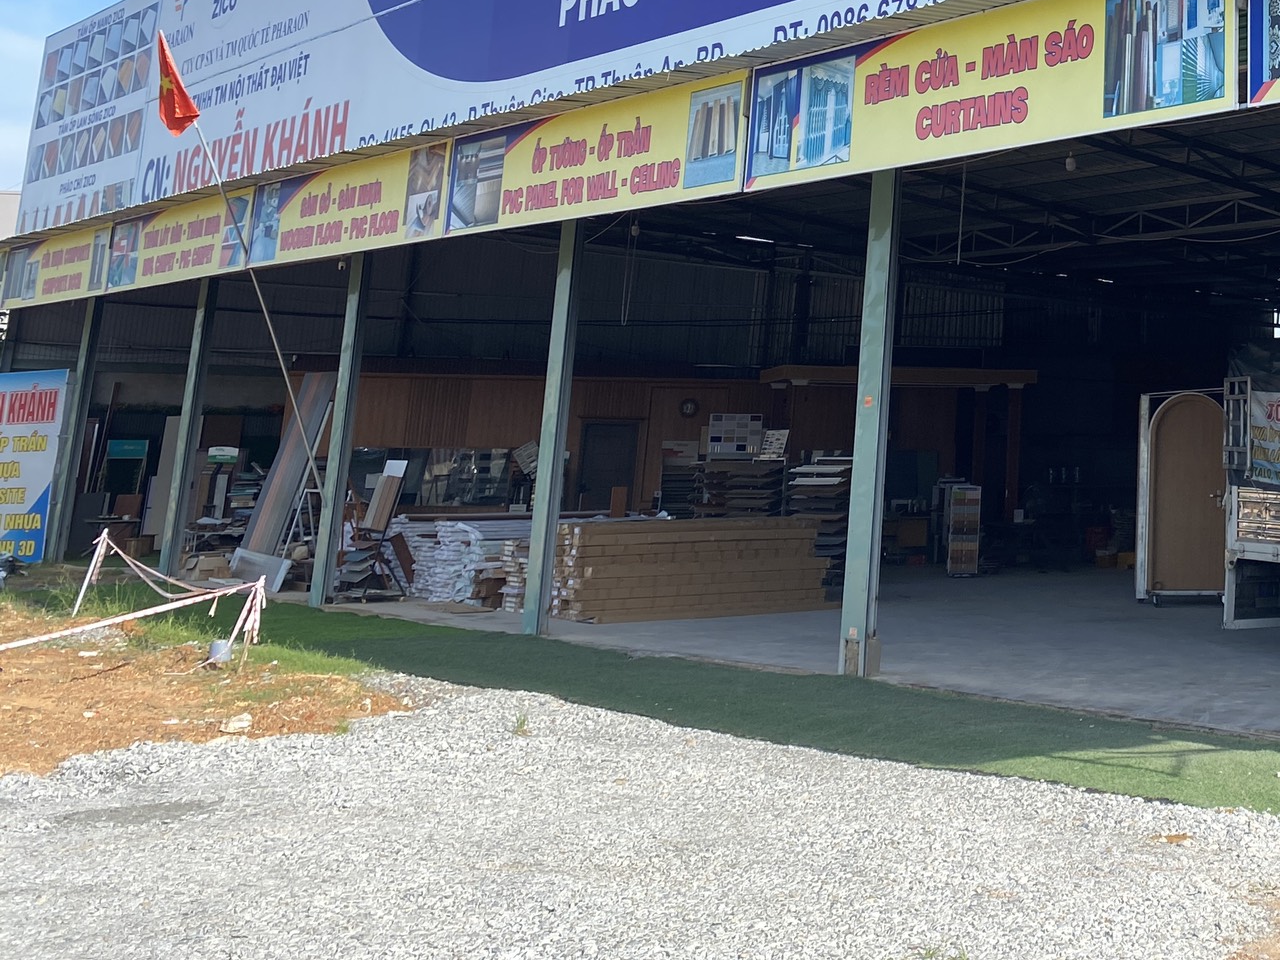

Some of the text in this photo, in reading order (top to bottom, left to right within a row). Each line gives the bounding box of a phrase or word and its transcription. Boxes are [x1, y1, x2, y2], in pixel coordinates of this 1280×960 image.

[215, 83, 228, 106] TM
[228, 74, 245, 106] NỘI
[247, 62, 270, 95] THẤT
[288, 50, 310, 85] VIỆT
[864, 62, 910, 106] RÈM
[914, 47, 959, 93] CỬA
[981, 34, 1039, 81] MÀN
[1044, 19, 1095, 68] SÁO
[915, 86, 1029, 141] CURTAINS
[142, 97, 350, 202] CN: NGUYỄN KHÁNH
[502, 187, 523, 216] PVC
[524, 180, 558, 212] PANEL
[560, 175, 585, 206] FOR
[587, 170, 618, 201] WALL
[630, 158, 681, 195] CEILING
[368, 210, 399, 238] FLOOR
[6, 384, 59, 425] KHÁNH
[18, 540, 35, 556] 3D
